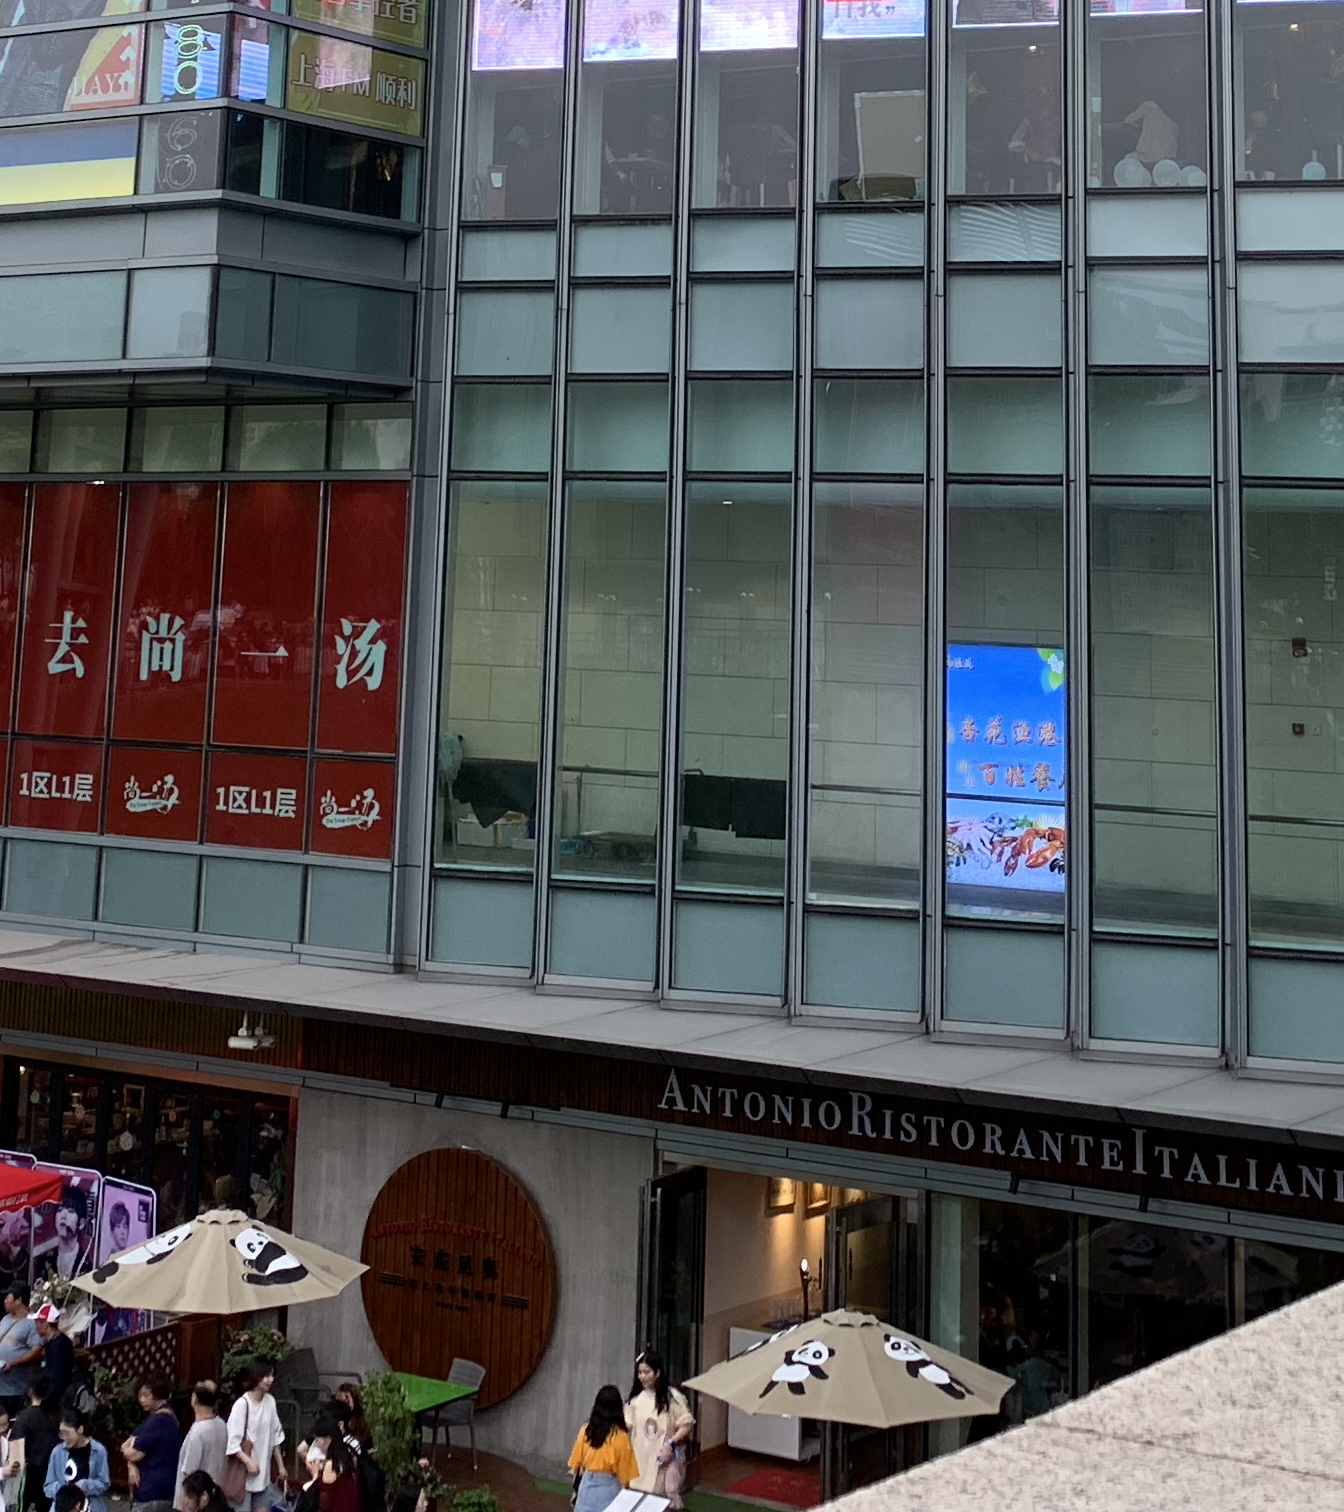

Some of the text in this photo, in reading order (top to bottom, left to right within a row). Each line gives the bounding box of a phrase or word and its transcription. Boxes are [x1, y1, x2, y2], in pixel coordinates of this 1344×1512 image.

[375, 70, 417, 111] 顺利
[18, 771, 94, 803] 1区L1层
[214, 785, 297, 819] 1区L1层
